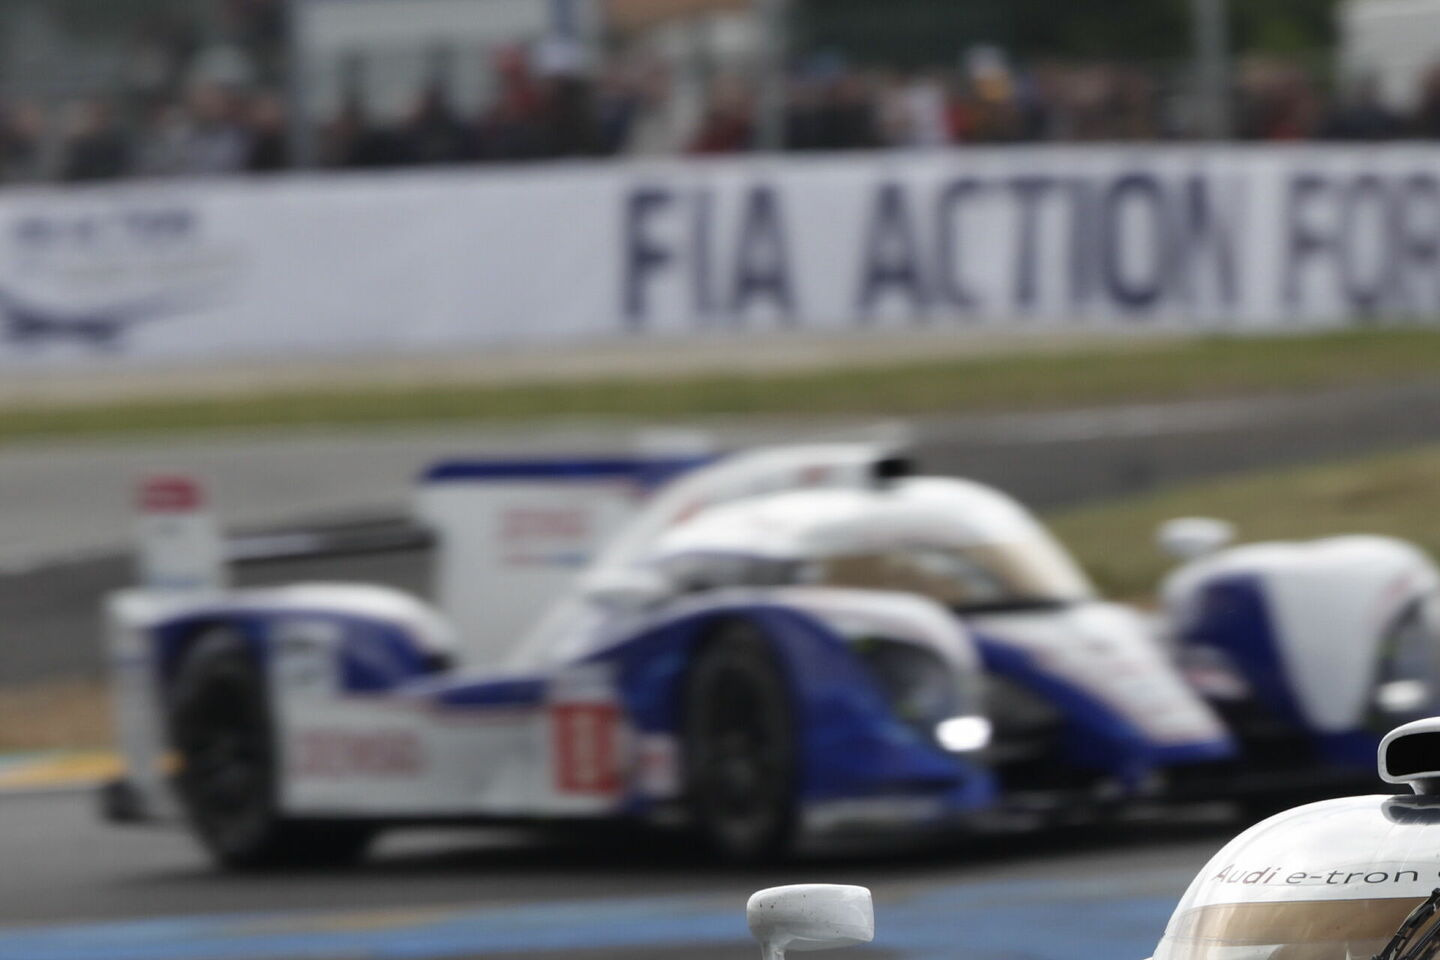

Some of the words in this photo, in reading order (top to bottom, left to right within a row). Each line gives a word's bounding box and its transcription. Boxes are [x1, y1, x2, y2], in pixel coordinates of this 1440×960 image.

[624, 183, 796, 330] FIA
[860, 170, 1242, 324] ACTION
[1211, 863, 1281, 885] Audi
[1286, 869, 1419, 886] e-tron
